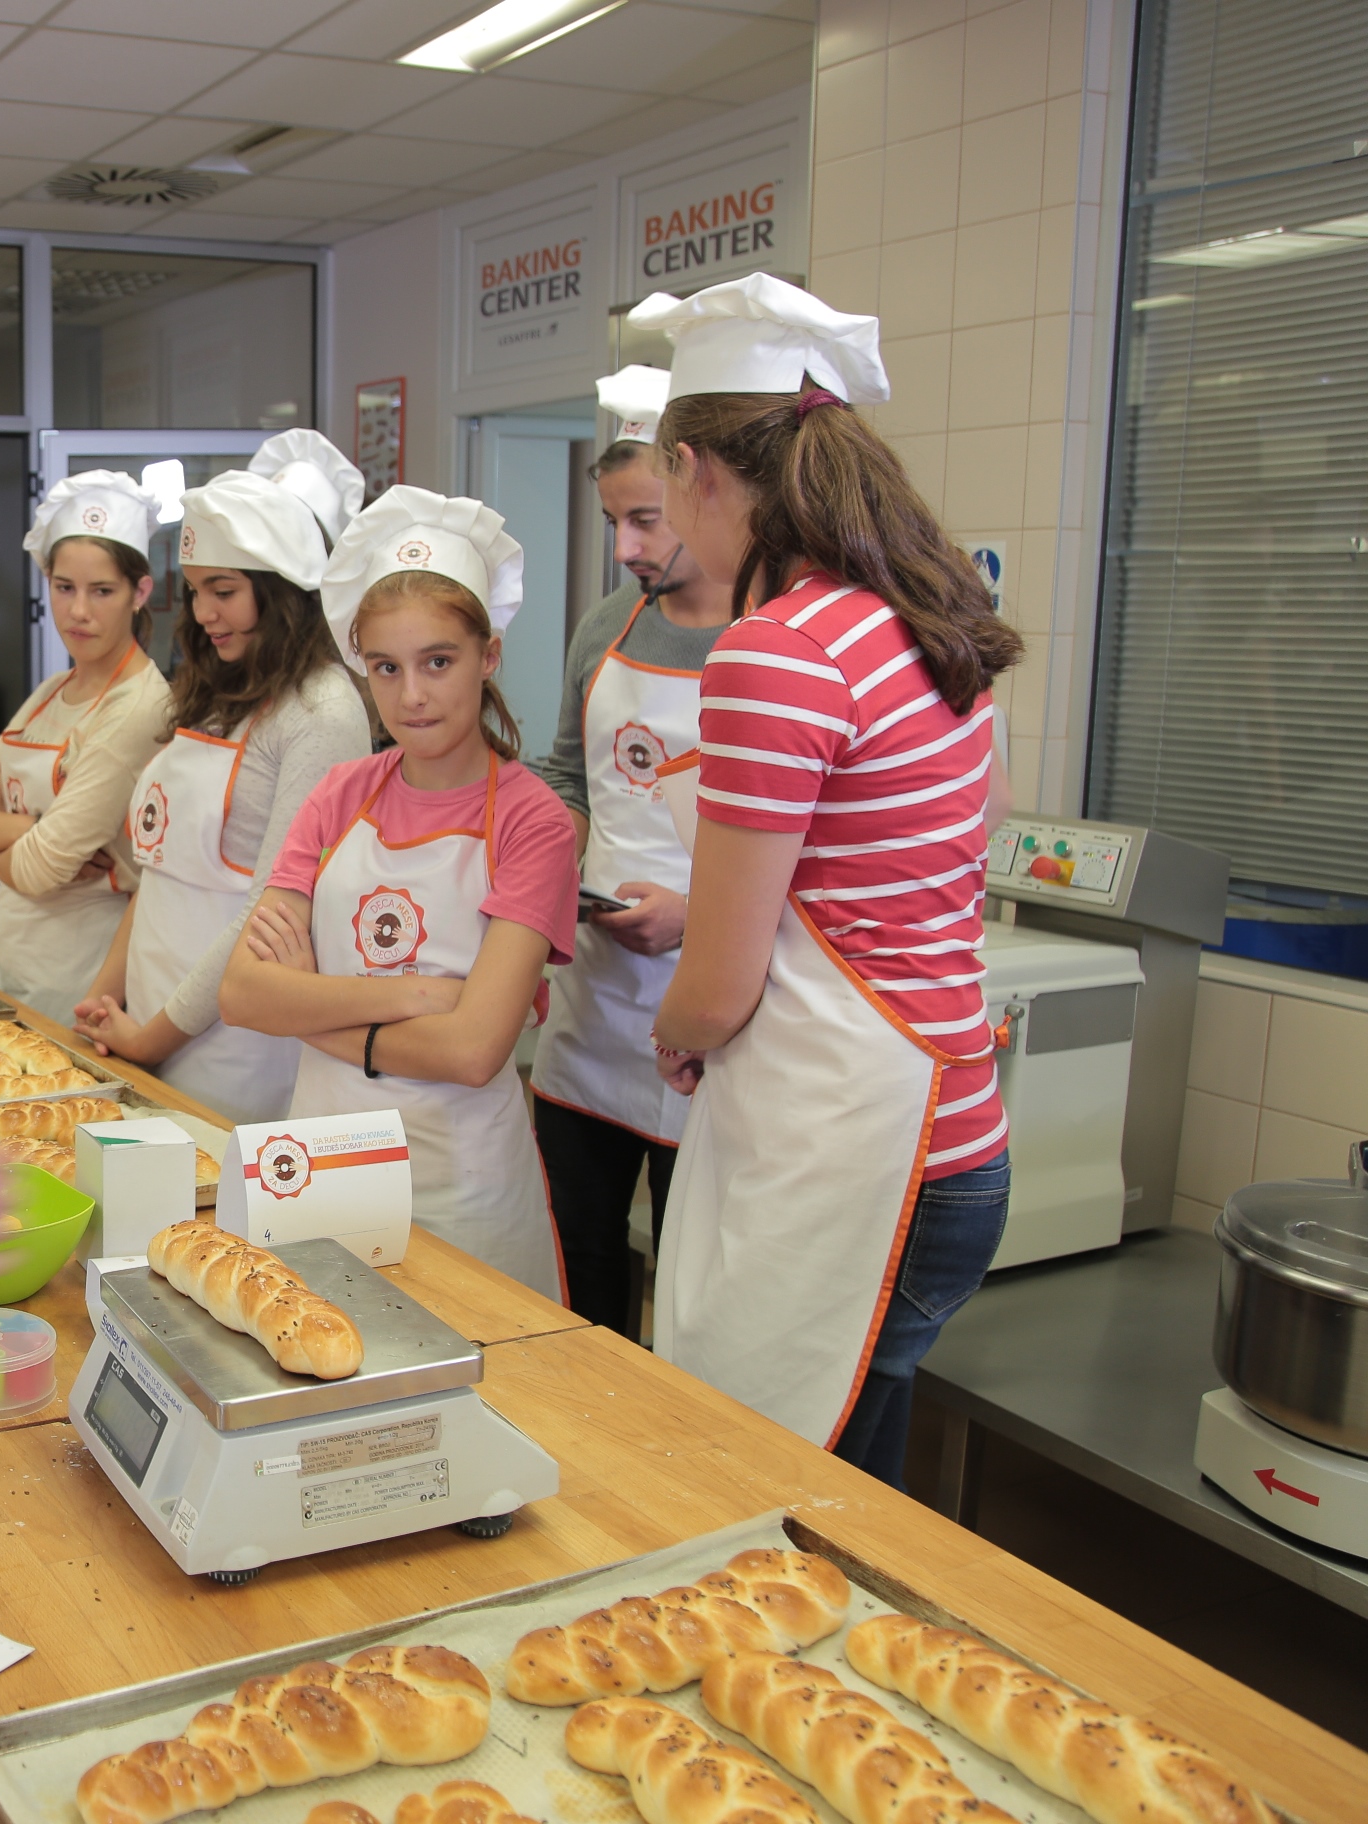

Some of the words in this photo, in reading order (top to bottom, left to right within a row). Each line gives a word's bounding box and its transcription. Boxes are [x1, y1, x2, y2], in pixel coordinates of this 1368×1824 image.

[644, 182, 775, 247] BAKING
[643, 217, 775, 278] CENTER
[481, 239, 581, 290] BAKING
[480, 270, 581, 318] CENTER
[370, 898, 395, 914] DECA
[396, 902, 413, 929] MESE
[365, 936, 374, 951] ZA
[312, 1137, 324, 1145] DA
[324, 1133, 350, 1145] RASTEŠ
[351, 1132, 367, 1141] KAO
[367, 1129, 395, 1139] KVASAC
[318, 1143, 339, 1153] BUDEŠ
[339, 1140, 363, 1151] DOBAR
[363, 1139, 378, 1148] KAO
[266, 1143, 284, 1159] DECA
[285, 1144, 304, 1161] MESE
[268, 1175, 278, 1187] ZA
[111, 1359, 125, 1378] CAS
